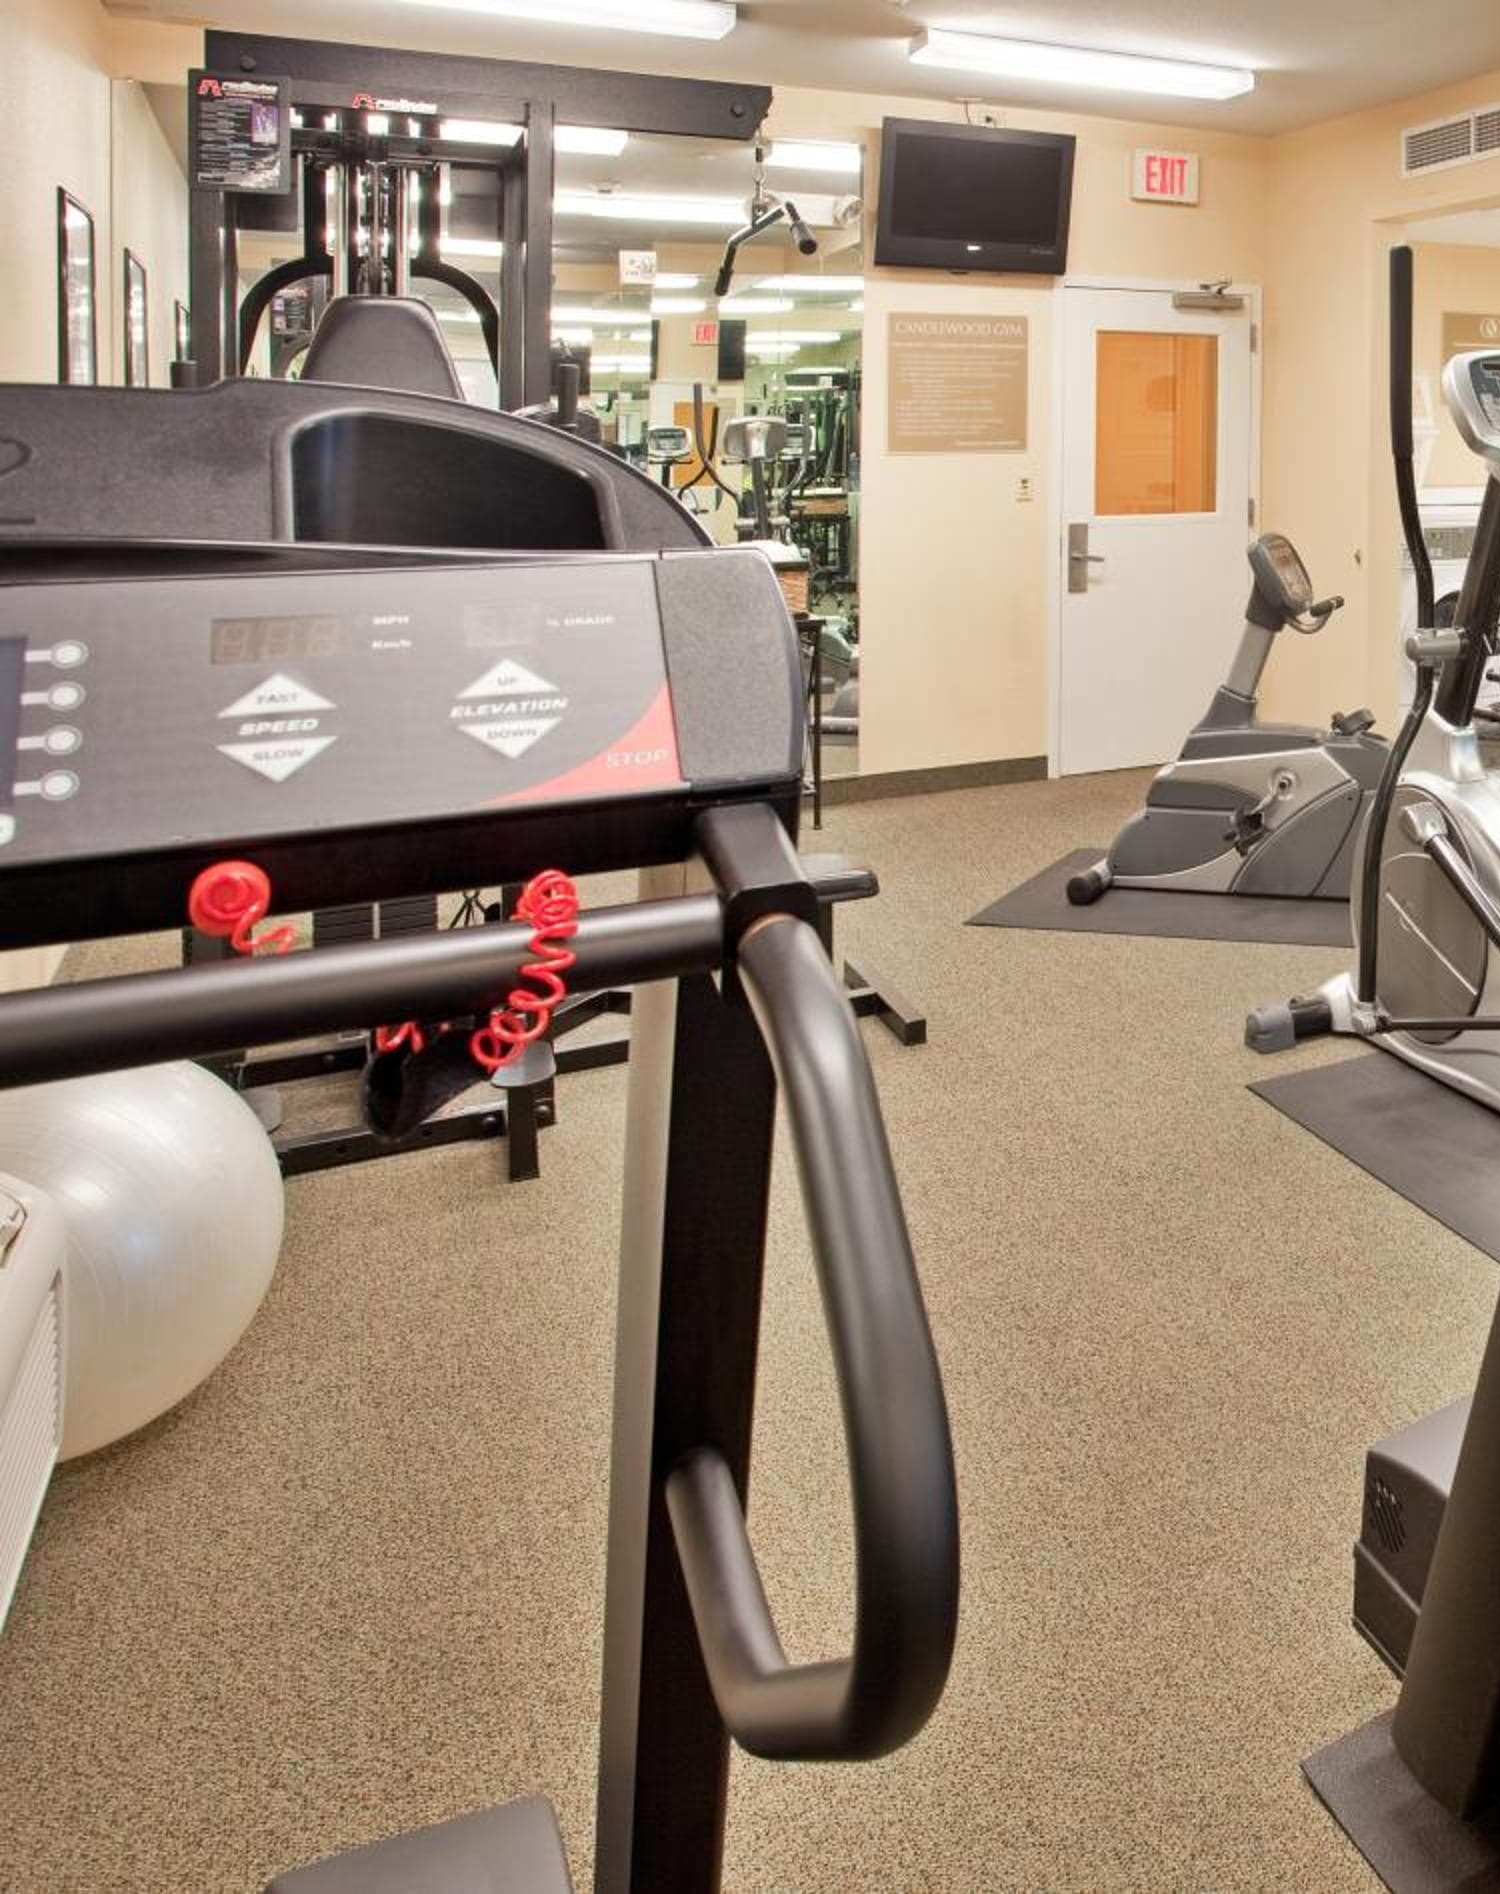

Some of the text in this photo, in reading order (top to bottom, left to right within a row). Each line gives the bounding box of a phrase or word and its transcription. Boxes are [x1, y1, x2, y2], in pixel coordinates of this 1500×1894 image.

[1145, 155, 1188, 195] EXIT
[497, 675, 517, 687] UP
[257, 692, 298, 706] FAST
[450, 697, 570, 719] ELEVATION
[238, 717, 320, 736] SPEED
[487, 728, 538, 741] DOWN
[253, 749, 304, 762] SLOW
[606, 749, 671, 768] STOP
